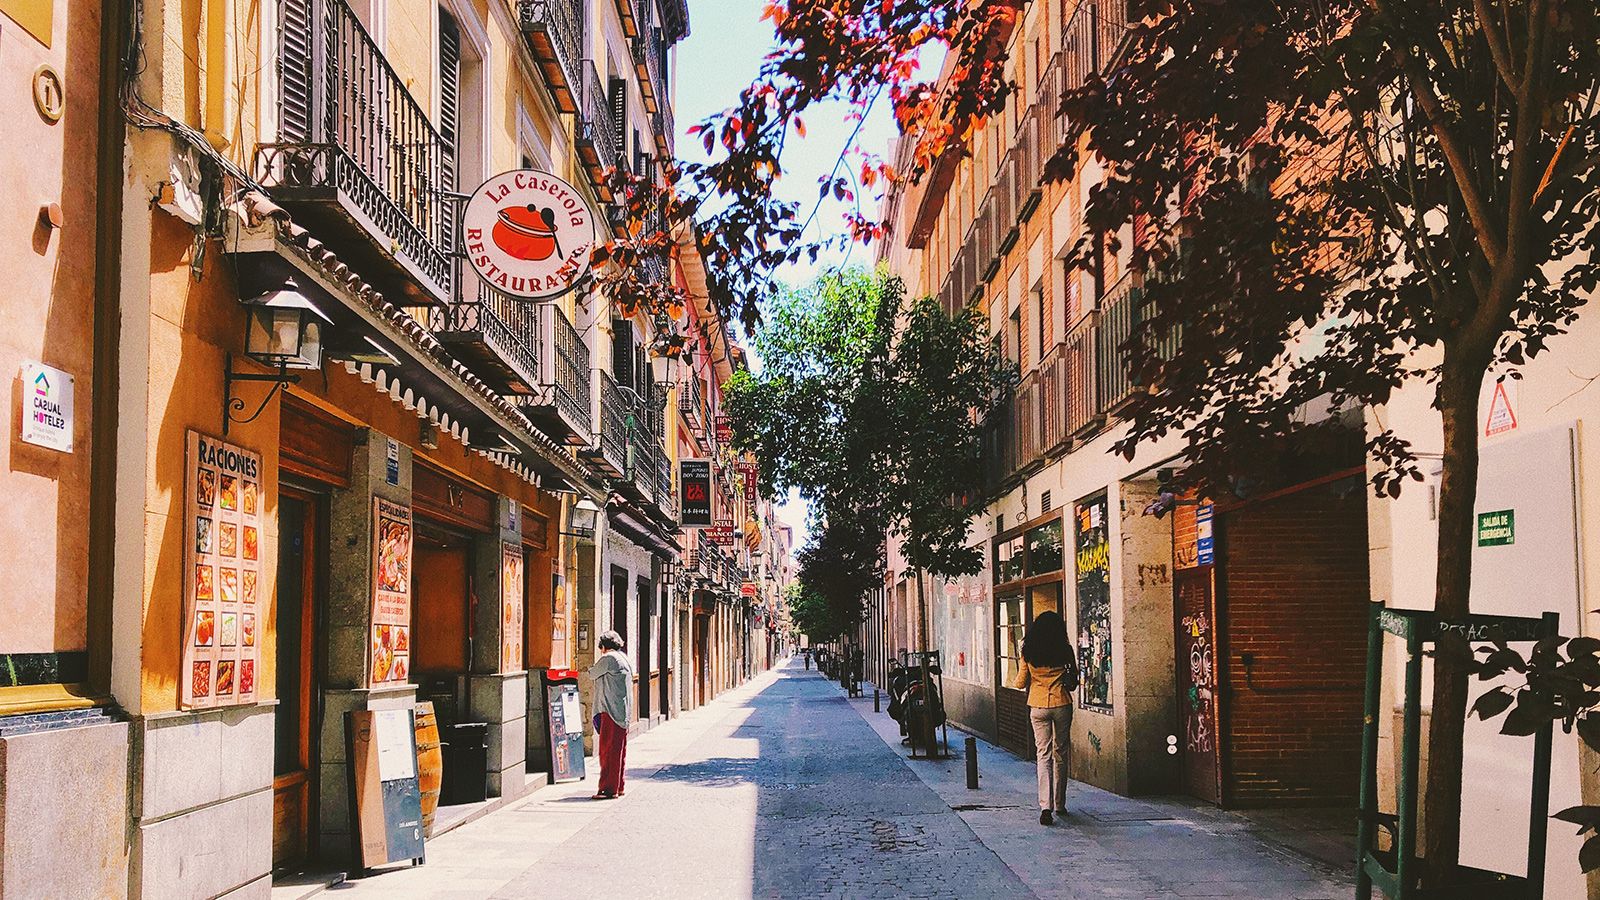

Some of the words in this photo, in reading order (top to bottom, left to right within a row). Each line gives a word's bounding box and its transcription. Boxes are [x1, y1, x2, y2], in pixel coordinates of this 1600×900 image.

[485, 183, 511, 204] La
[514, 173, 585, 227] Caserola
[467, 228, 587, 293] RESTAURANT
[33, 397, 61, 416] CASUAL
[33, 410, 65, 430] HOTELES
[199, 440, 257, 479] RACIONES
[1483, 516, 1500, 528] SALIDA
[1501, 514, 1508, 526] DE
